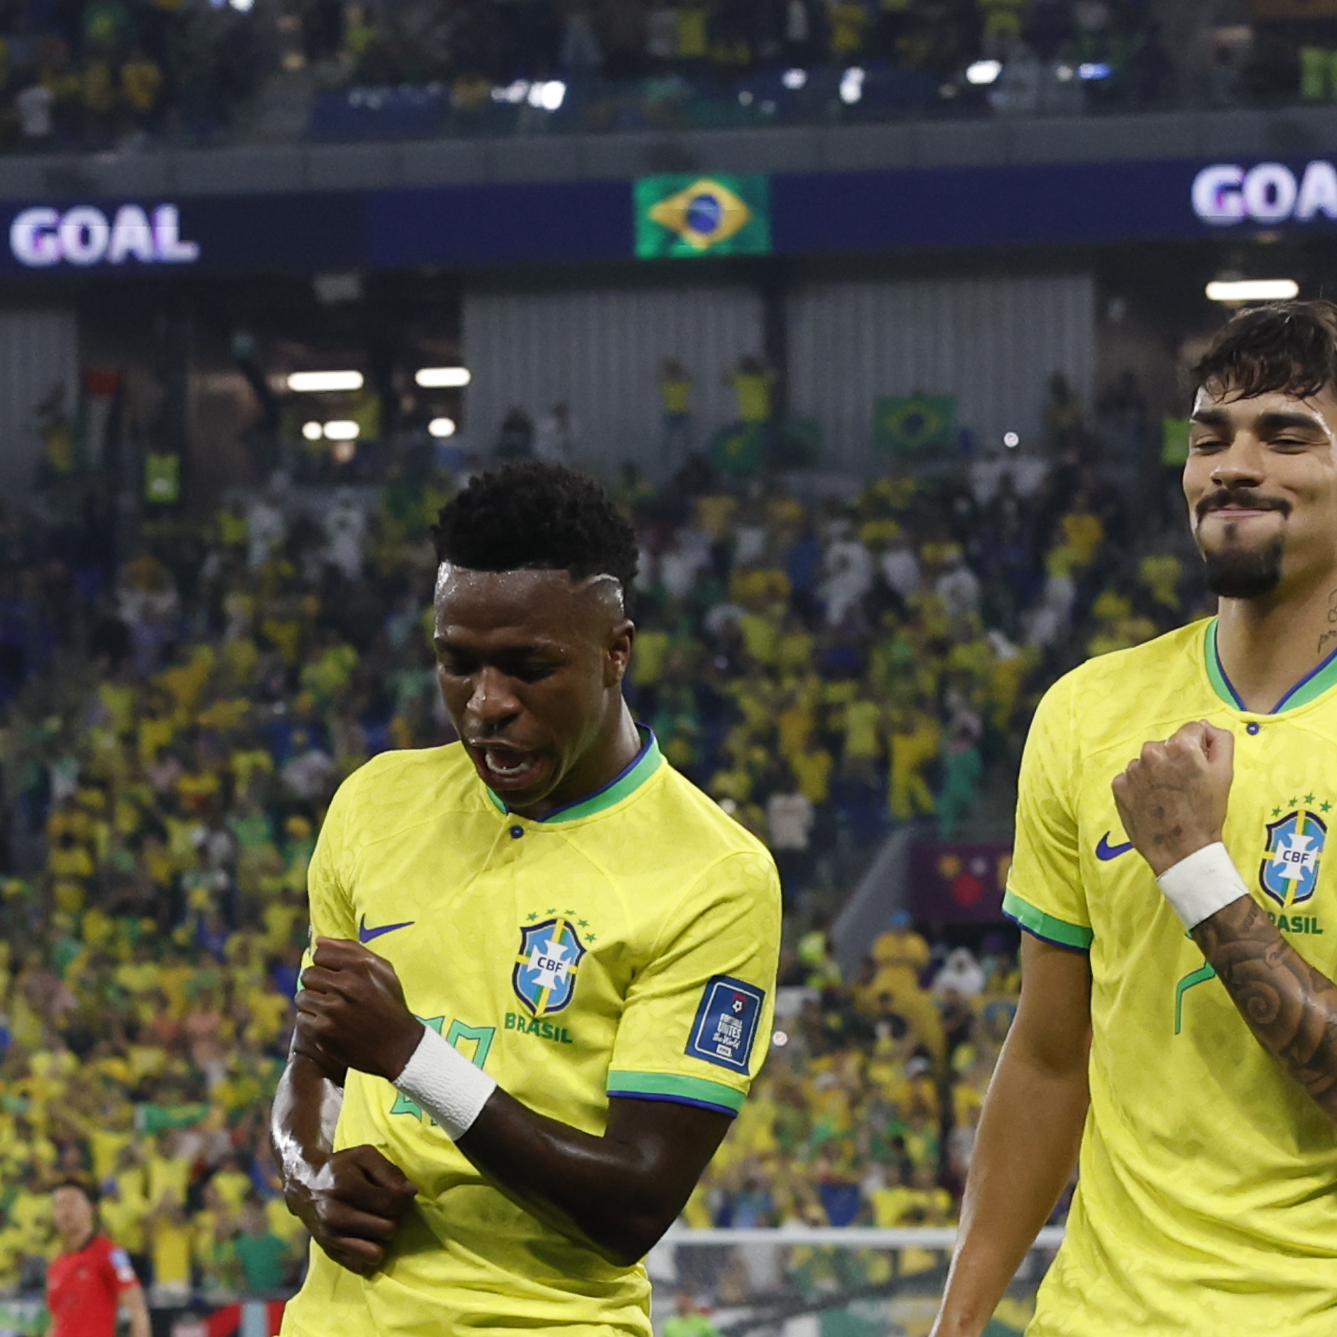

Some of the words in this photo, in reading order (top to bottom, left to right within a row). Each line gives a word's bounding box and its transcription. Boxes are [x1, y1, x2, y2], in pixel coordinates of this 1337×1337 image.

[9, 203, 201, 268] GOAL
[1282, 850, 1311, 865] CBF
[537, 956, 563, 974] CBF
[504, 1012, 573, 1044] BRASIL
